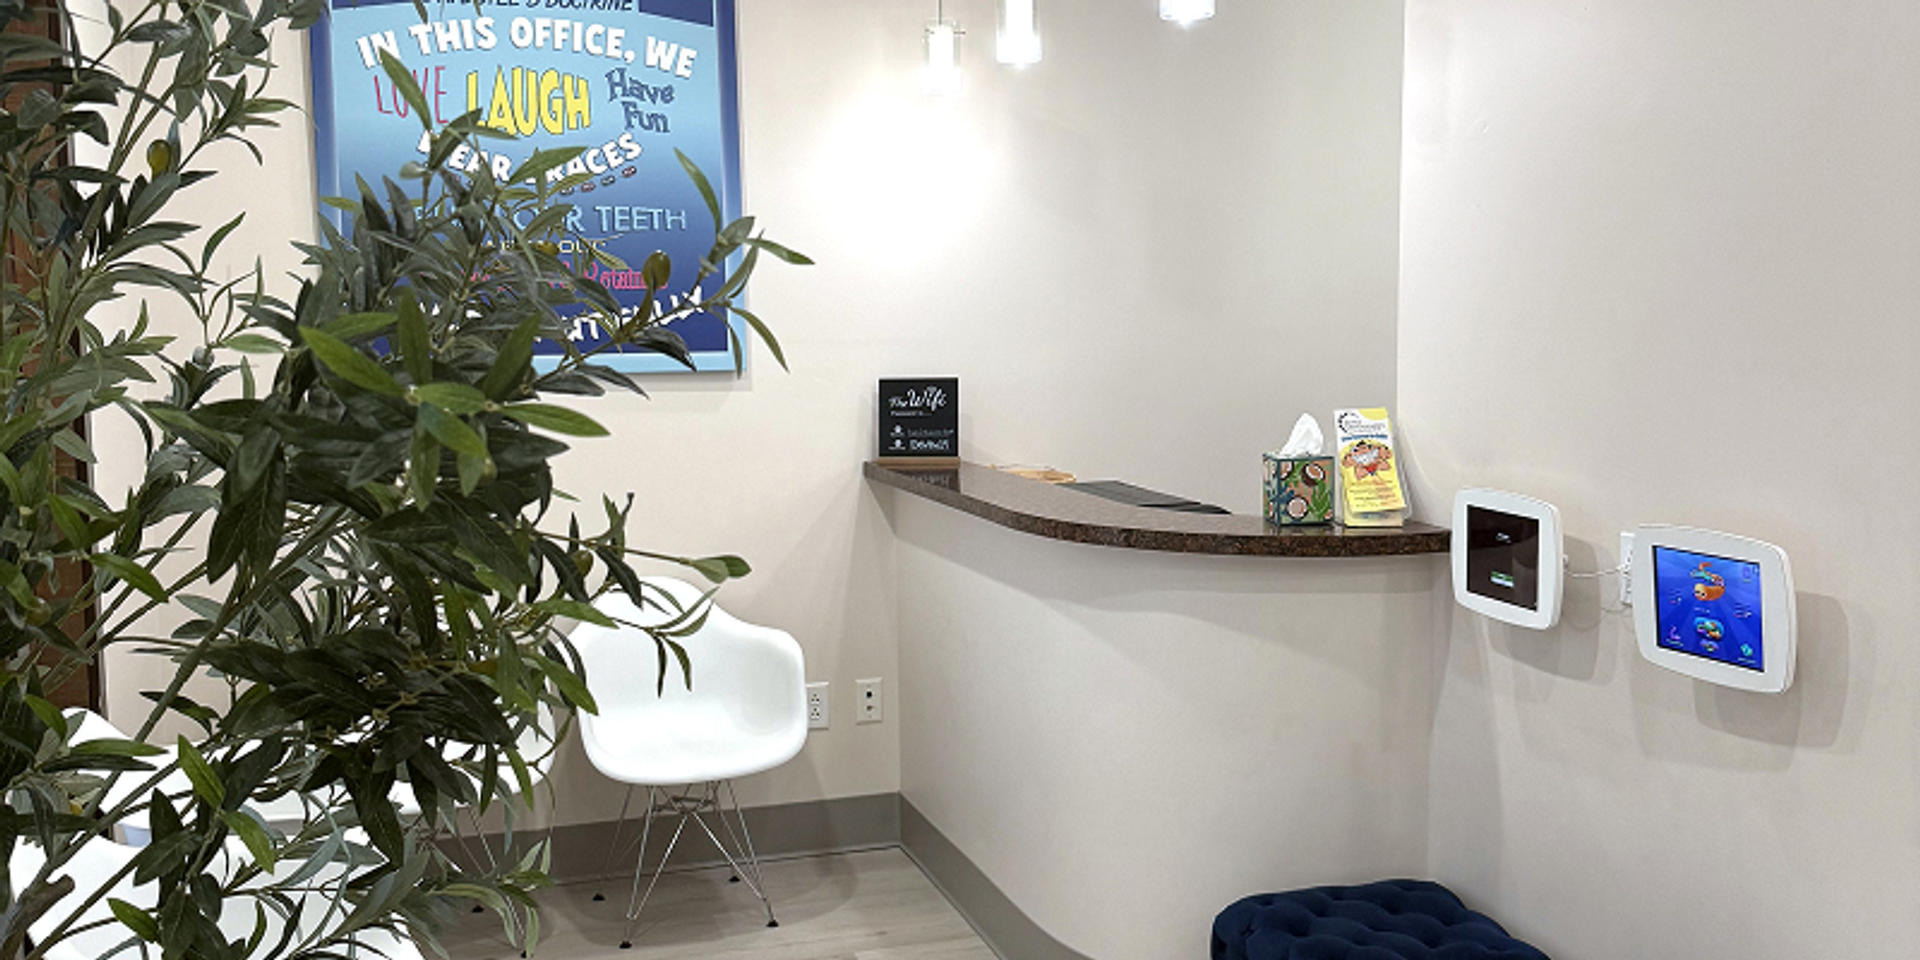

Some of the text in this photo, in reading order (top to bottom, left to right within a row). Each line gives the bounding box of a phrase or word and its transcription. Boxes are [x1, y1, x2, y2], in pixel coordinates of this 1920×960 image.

[356, 16, 697, 79] IN THIS OFFICE, WE
[466, 65, 591, 137] LAUGH
[605, 67, 675, 105] Have
[621, 101, 670, 134] Fun
[595, 206, 687, 232] TEETH
